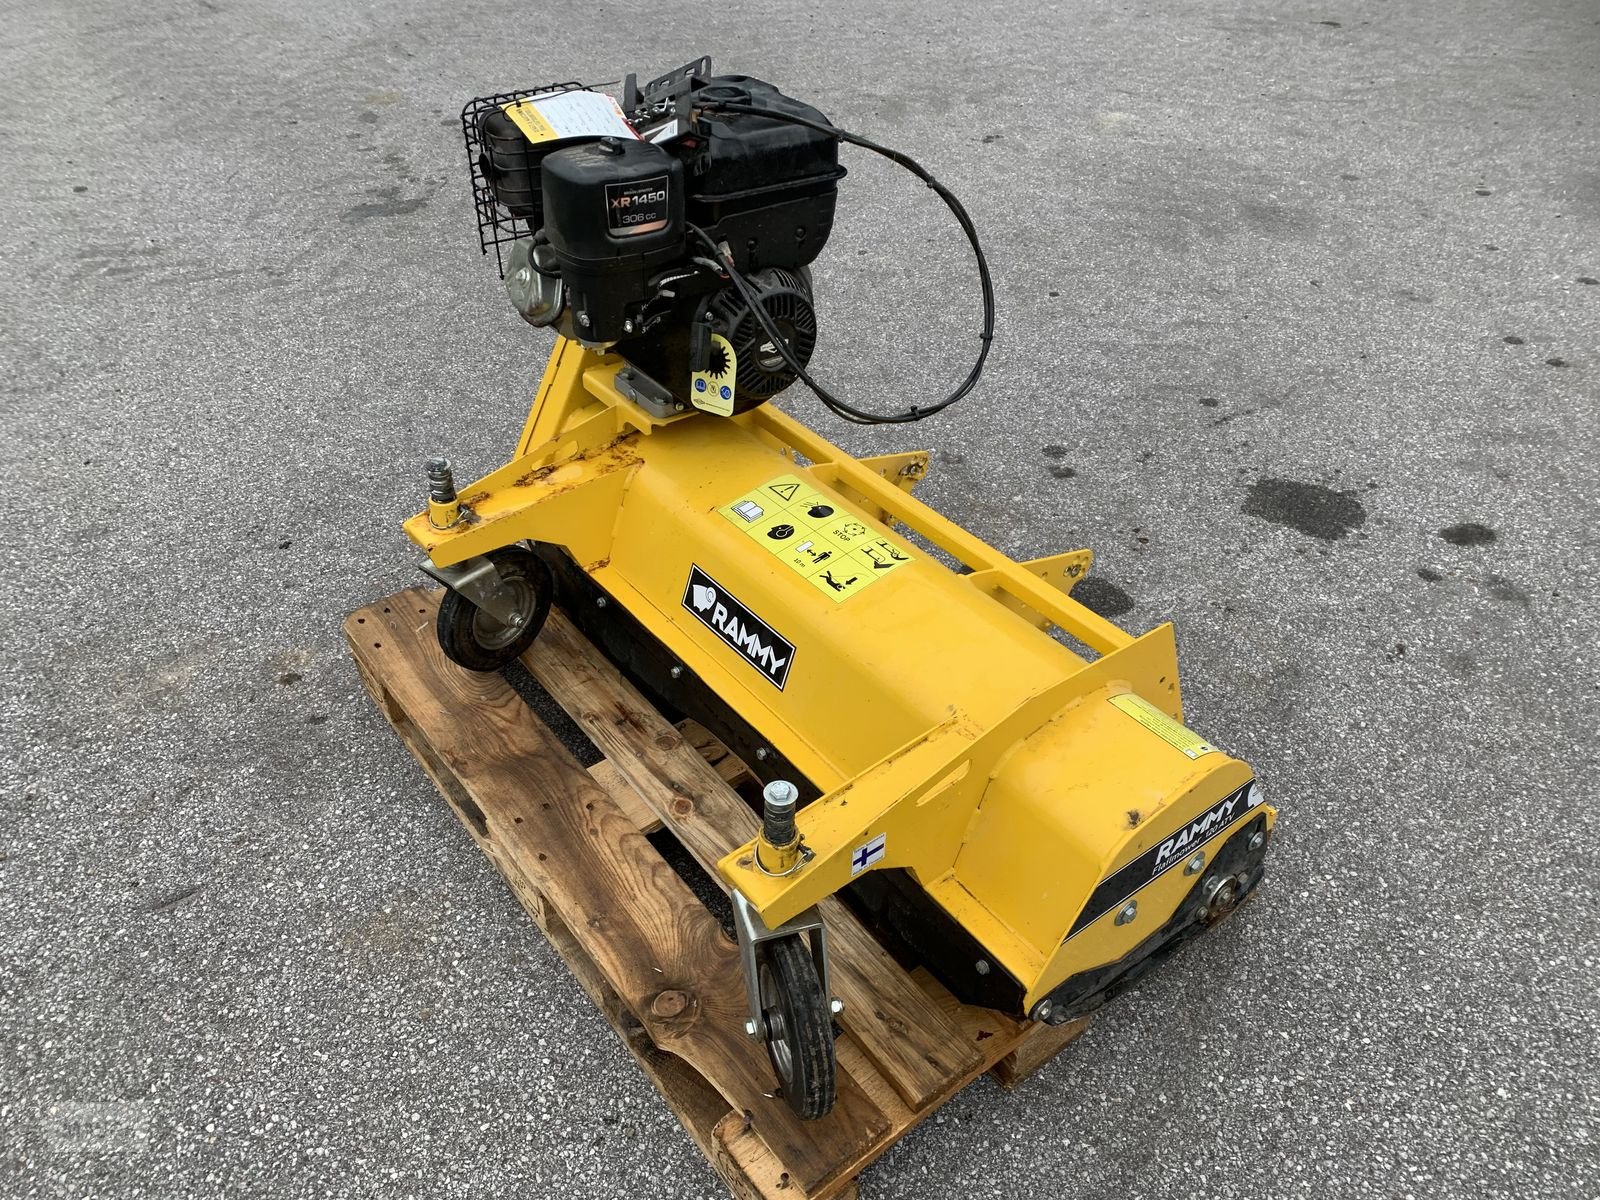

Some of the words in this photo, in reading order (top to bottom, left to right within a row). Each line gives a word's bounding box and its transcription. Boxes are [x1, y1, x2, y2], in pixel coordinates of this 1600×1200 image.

[610, 190, 665, 208] XR1450
[622, 213, 644, 224] 306
[645, 212, 657, 220] cc
[832, 529, 851, 543] STOP
[711, 601, 786, 675] RAMMY
[1155, 790, 1244, 865] RAMMY
[1205, 824, 1219, 838] 120
[1218, 812, 1235, 829] ATV
